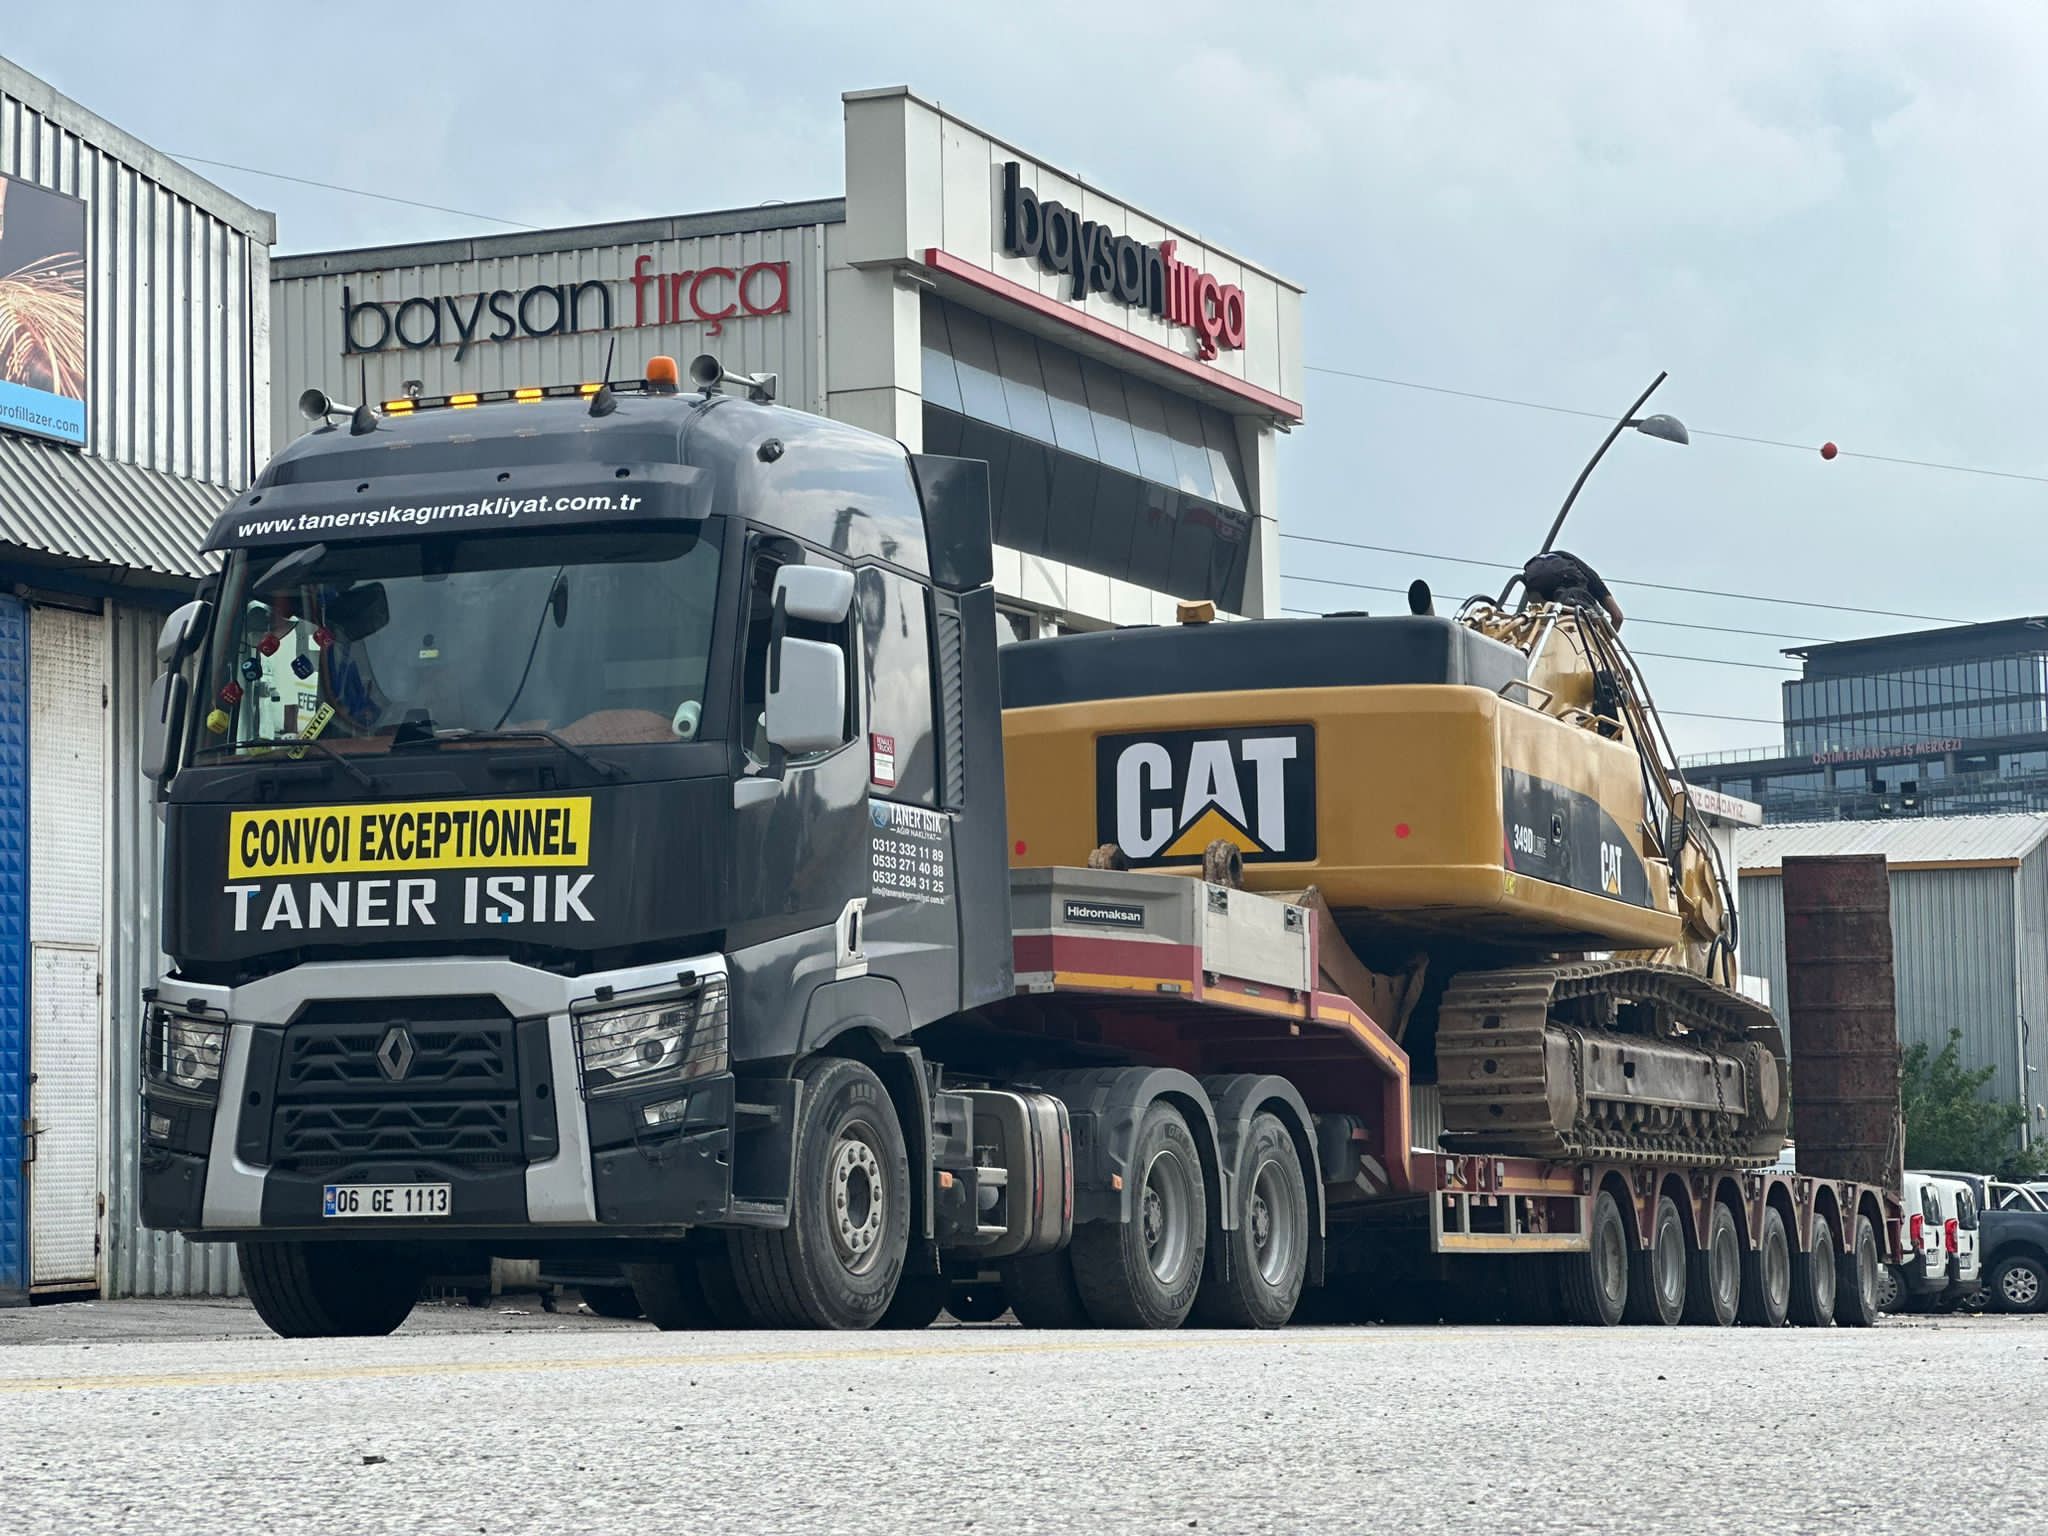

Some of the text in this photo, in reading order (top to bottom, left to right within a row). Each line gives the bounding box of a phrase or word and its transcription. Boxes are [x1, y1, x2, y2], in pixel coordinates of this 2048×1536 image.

[1003, 161, 1166, 316] baysan
[343, 255, 790, 362] baysan fırça
[889, 805, 921, 829] TANER
[1115, 736, 1297, 859] CAT
[241, 808, 577, 868] CONVOI EXCEPTIONNEL
[873, 838, 944, 862] 0312 332 11 89
[873, 854, 897, 869] 0533
[899, 858, 916, 873] 271
[919, 862, 931, 875] 40
[873, 870, 944, 893] 0532 294 31 25
[1600, 841, 1622, 895] CAT
[223, 878, 437, 932] TANER
[1067, 906, 1141, 922] Hidromaksan
[337, 1190, 359, 1212] 06
[372, 1189, 394, 1213] GE
[405, 1188, 447, 1212] 1113
